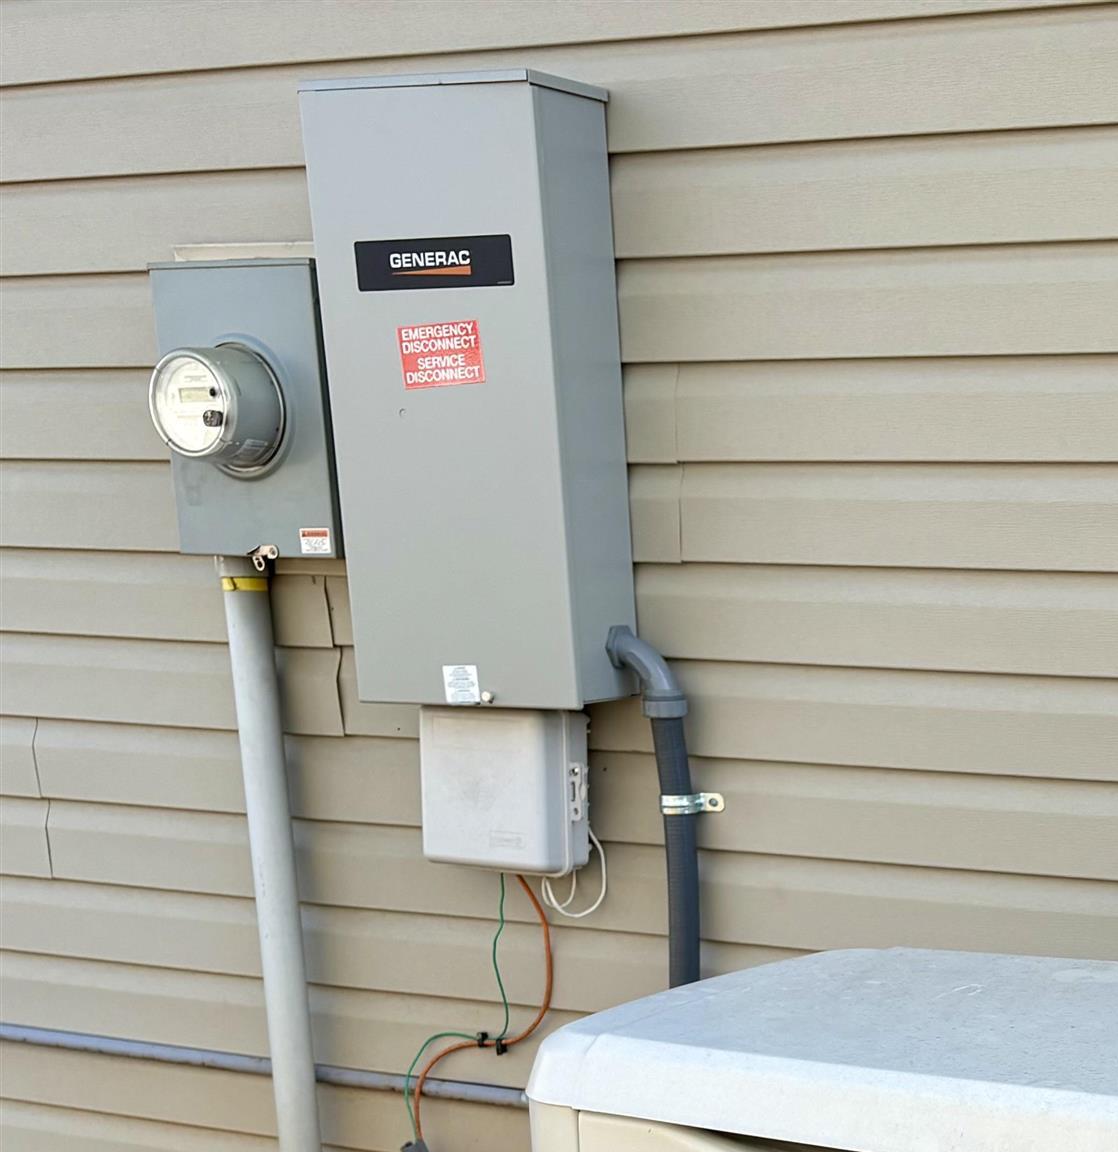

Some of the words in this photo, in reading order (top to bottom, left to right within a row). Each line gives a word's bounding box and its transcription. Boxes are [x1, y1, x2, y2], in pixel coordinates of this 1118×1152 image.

[389, 250, 471, 269] GENERAC
[401, 322, 474, 341] EMERGENCY
[402, 335, 477, 354] DISCONNECT
[417, 354, 466, 370] SERVICE
[406, 365, 481, 384] DISCONNECT
